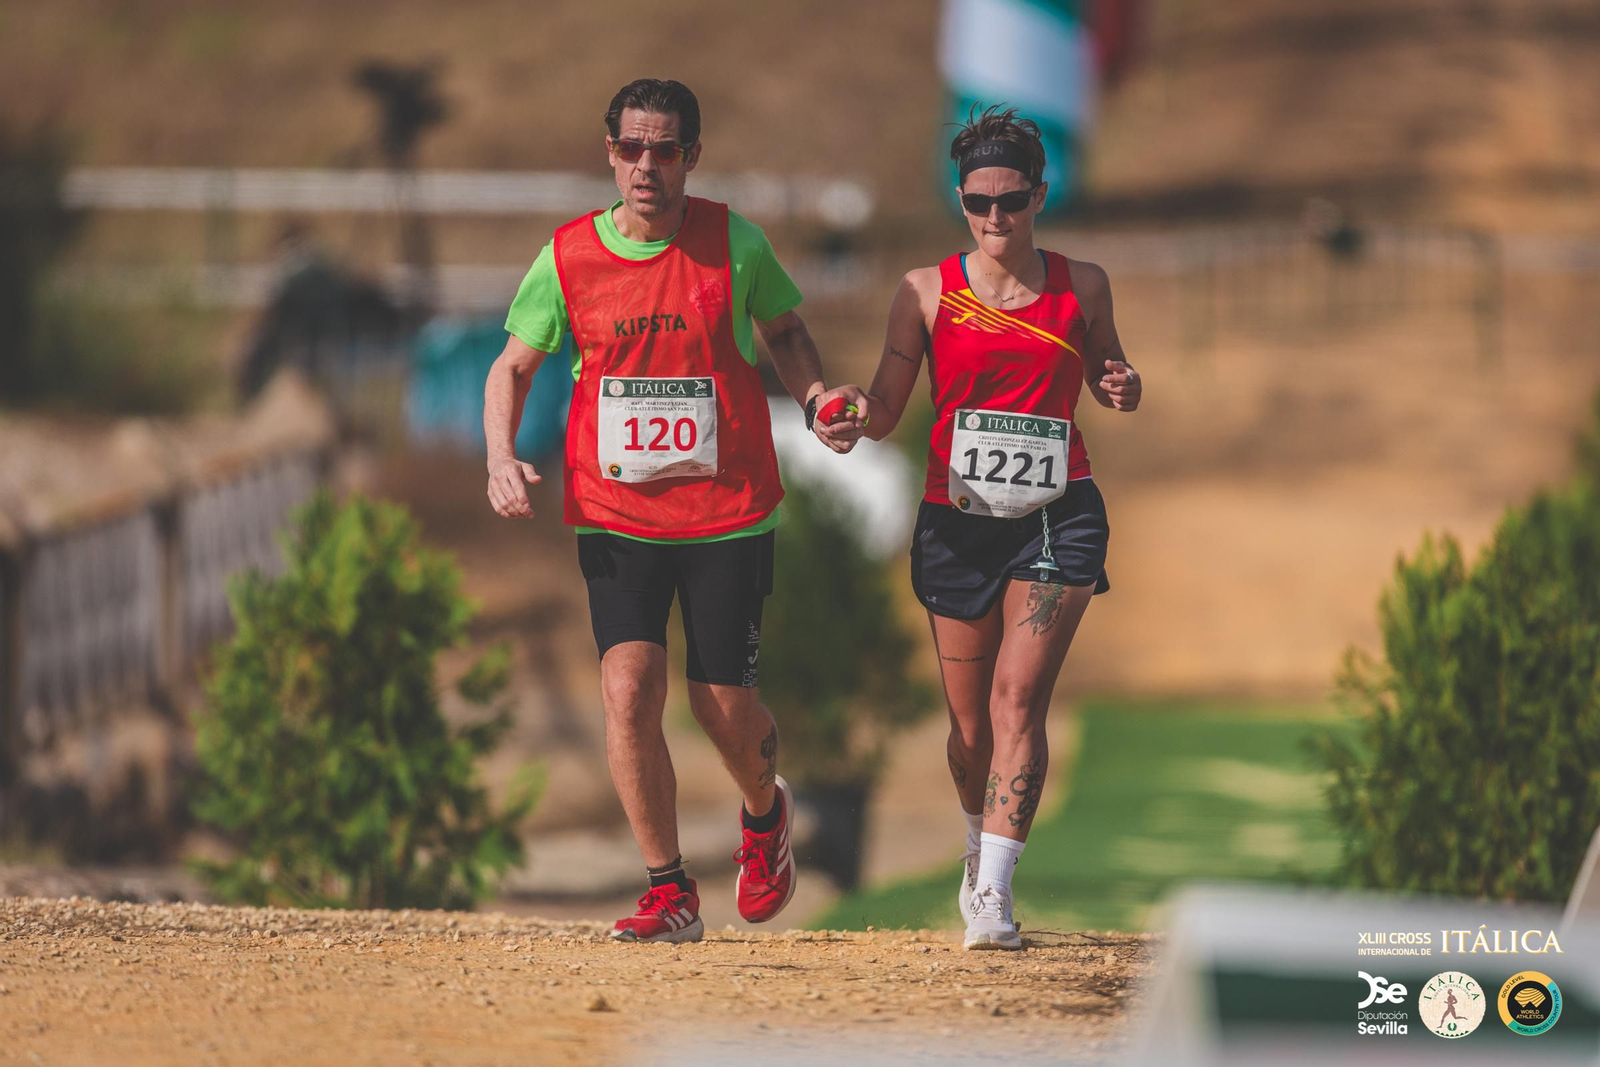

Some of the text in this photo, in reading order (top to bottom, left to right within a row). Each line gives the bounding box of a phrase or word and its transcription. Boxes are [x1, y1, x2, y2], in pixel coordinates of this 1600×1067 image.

[614, 313, 688, 338] KIPSTA
[632, 380, 686, 395] ITÁLICA
[624, 417, 697, 452] 120
[987, 416, 1040, 433] ITÁLICA
[961, 447, 1057, 489] 1221
